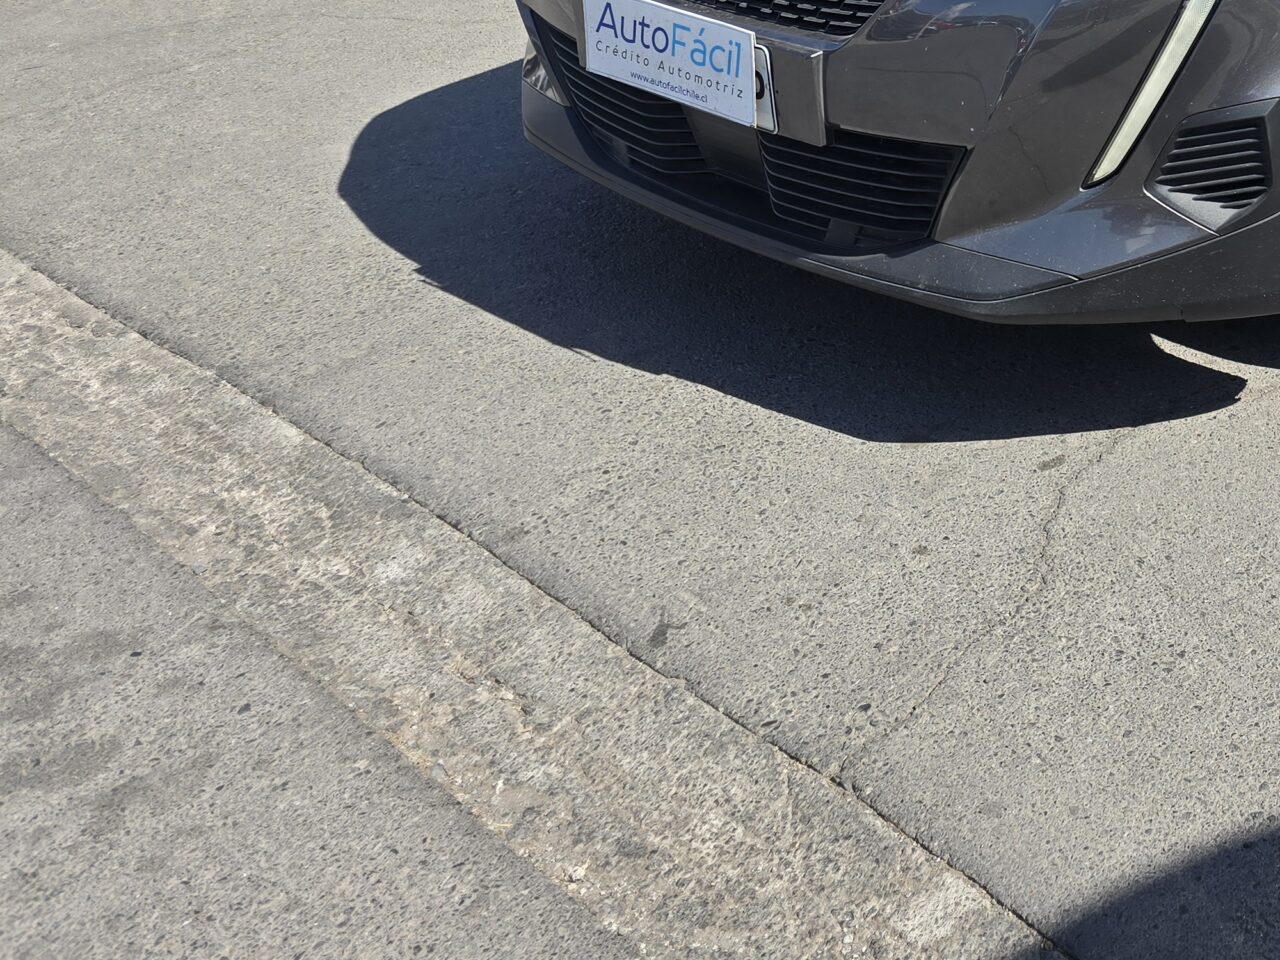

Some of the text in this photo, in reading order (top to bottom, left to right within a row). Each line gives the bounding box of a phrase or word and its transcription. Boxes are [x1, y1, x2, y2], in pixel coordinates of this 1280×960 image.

[595, 2, 742, 78] AutoFácil
[595, 41, 650, 67] Crédito
[657, 61, 744, 99] Automotriz
[630, 71, 708, 103] www.autofacilchile.cl
